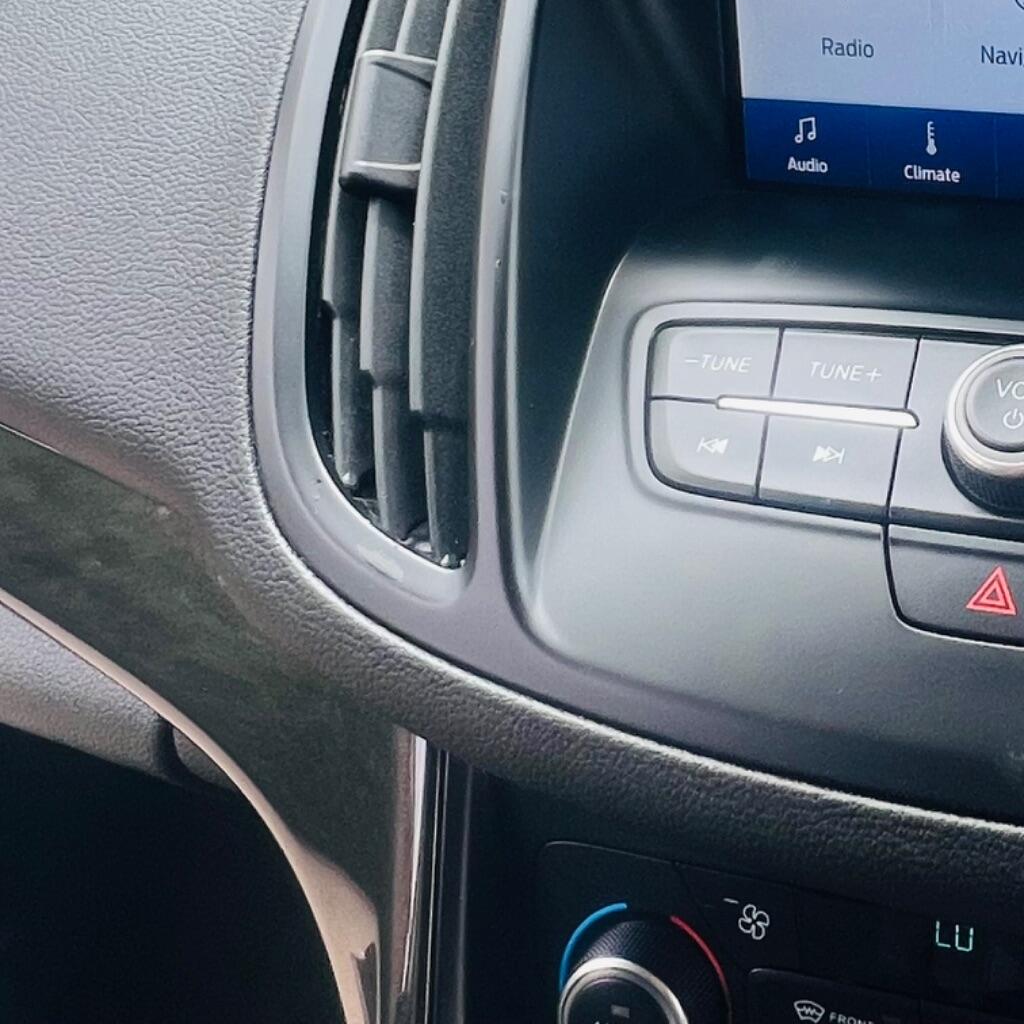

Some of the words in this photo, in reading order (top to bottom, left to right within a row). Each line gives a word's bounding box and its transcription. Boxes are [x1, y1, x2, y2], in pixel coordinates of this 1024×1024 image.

[821, 37, 875, 59] Radio
[787, 156, 829, 174] Audio
[903, 163, 961, 184] Climate
[829, 1011, 875, 1024] FRO
